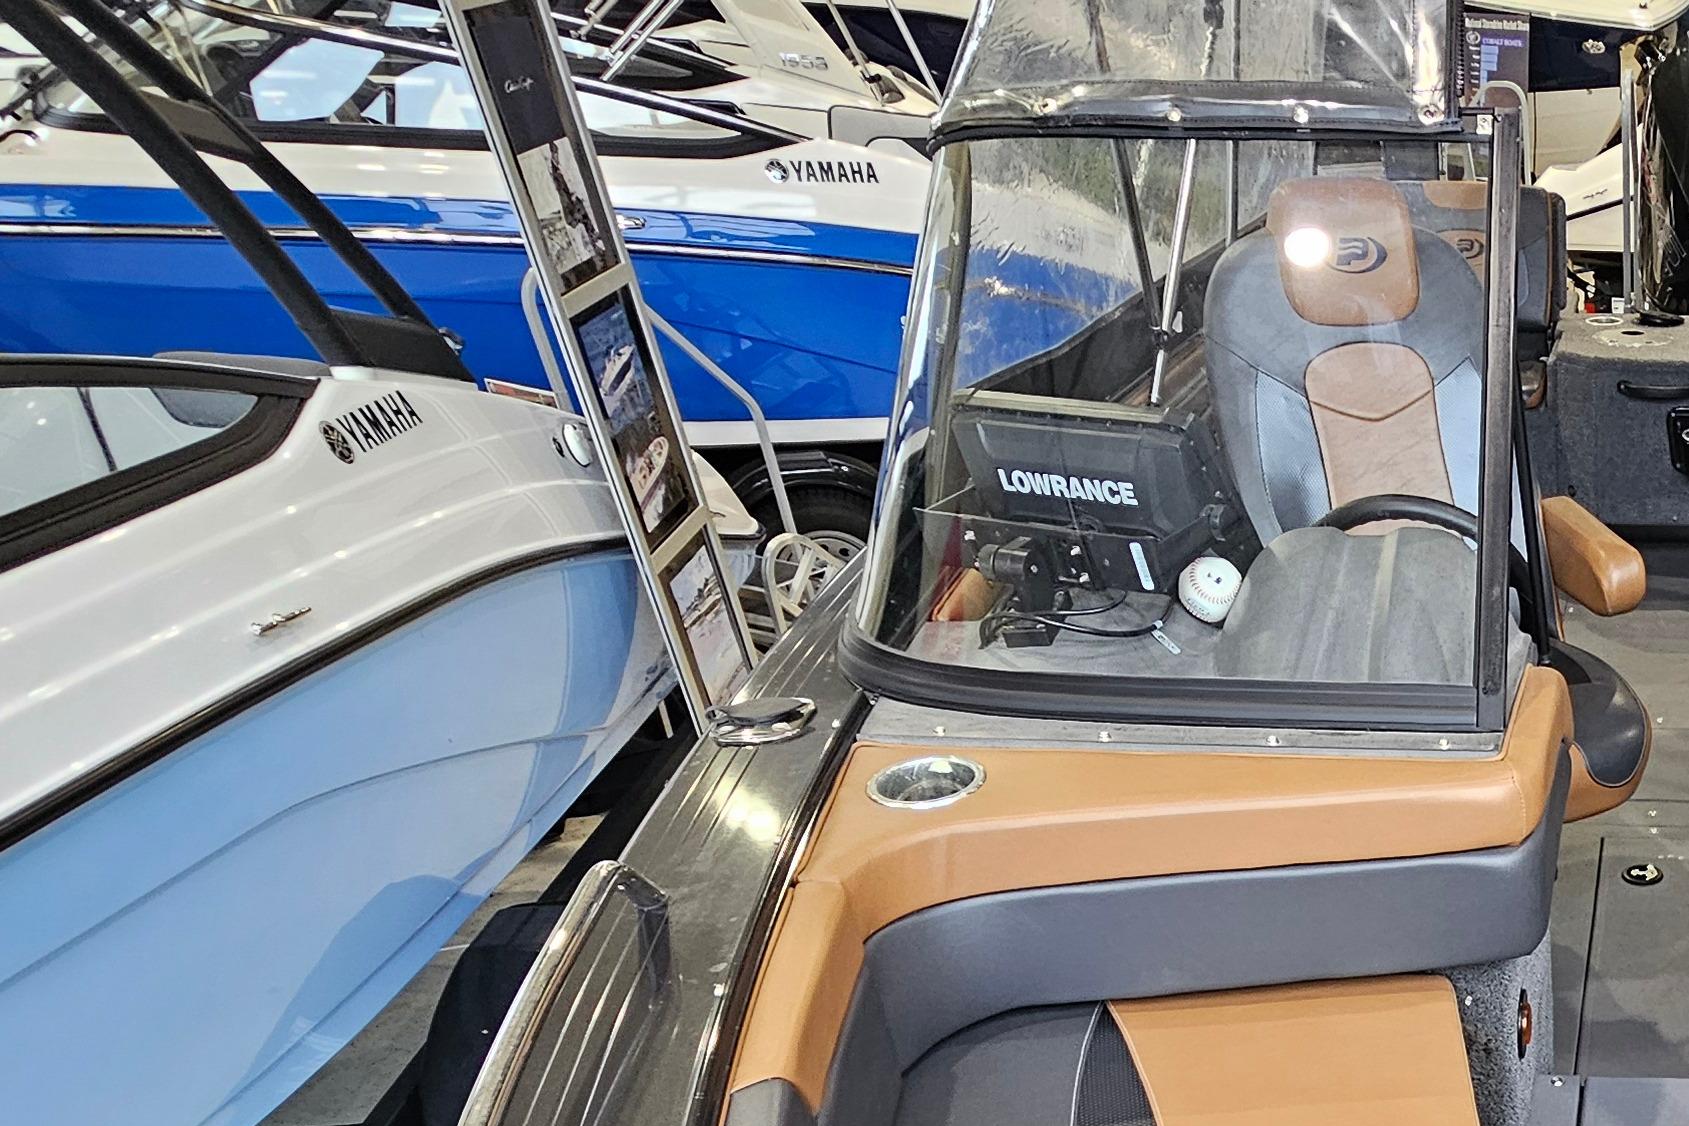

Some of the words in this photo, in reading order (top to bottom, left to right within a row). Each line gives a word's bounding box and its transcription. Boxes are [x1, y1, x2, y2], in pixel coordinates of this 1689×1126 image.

[789, 160, 880, 184] YAMAHA
[335, 390, 423, 453] YAMAHA
[997, 468, 1139, 506] LOWRANCE
